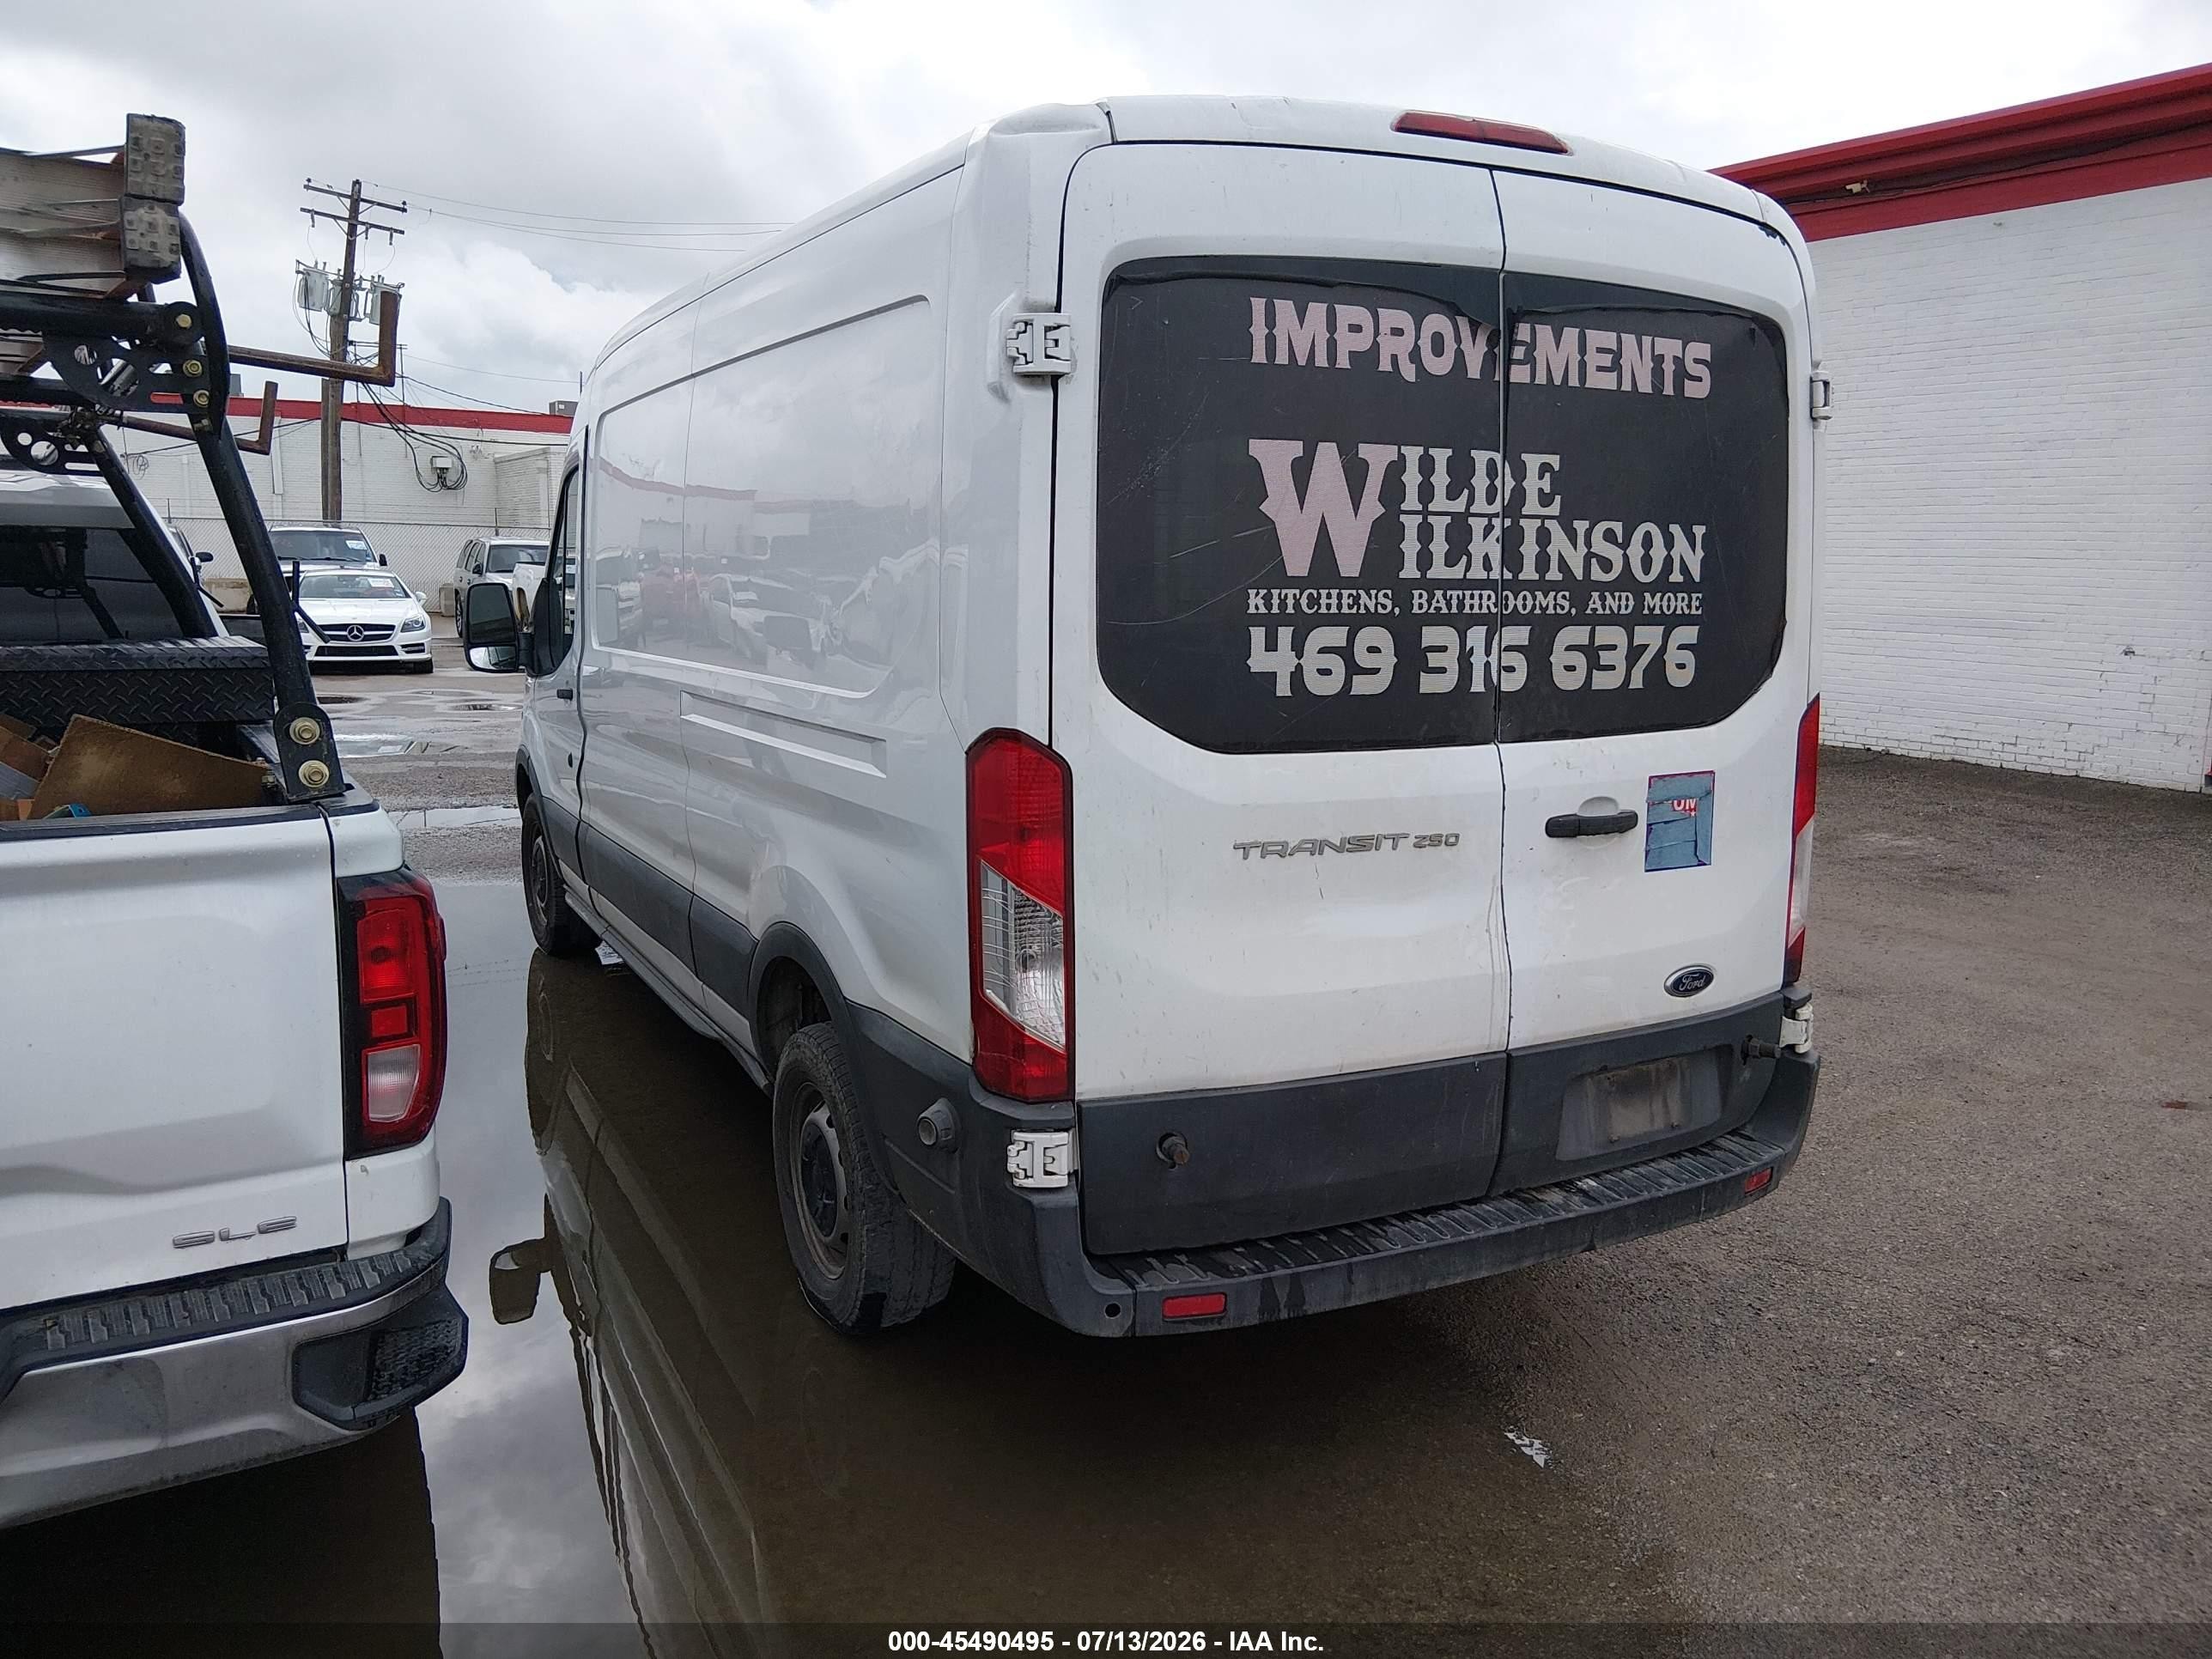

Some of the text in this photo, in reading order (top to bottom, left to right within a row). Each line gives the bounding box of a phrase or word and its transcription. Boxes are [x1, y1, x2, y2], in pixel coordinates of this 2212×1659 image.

[1249, 296, 1713, 400] IMPROVEMENTS
[1247, 587, 1703, 617] KITCHENS, BATHROOMS, AND MORE
[1247, 624, 1701, 697] 469 316 6376
[1233, 832, 1461, 860] TRANSIT 250
[1679, 973, 1706, 991] Ford
[173, 1216, 297, 1249] SLE
